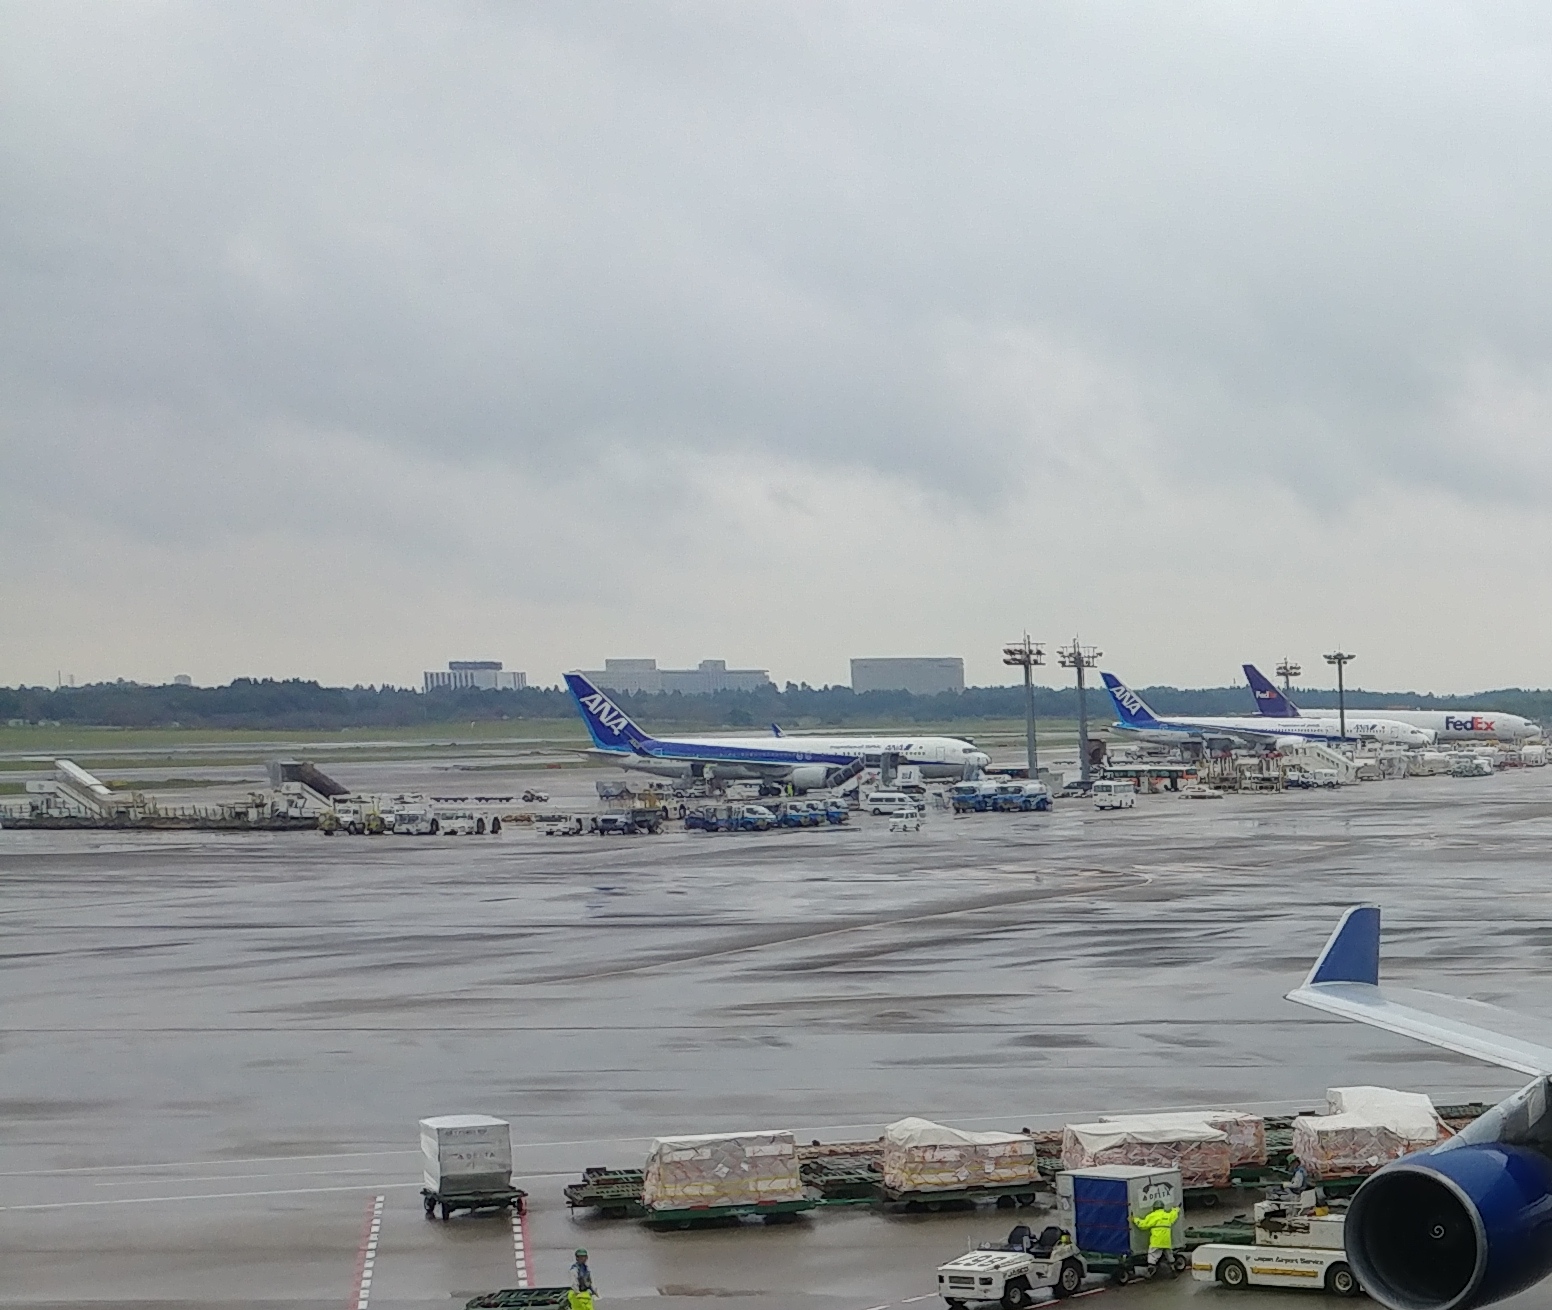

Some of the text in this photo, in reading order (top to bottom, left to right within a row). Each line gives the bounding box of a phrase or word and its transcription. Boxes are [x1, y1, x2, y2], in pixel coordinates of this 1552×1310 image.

[1110, 686, 1140, 716] ANA
[580, 693, 628, 736] ANA
[1445, 716, 1496, 731] FedEx
[1254, 1256, 1324, 1266] Japan Airport Service
